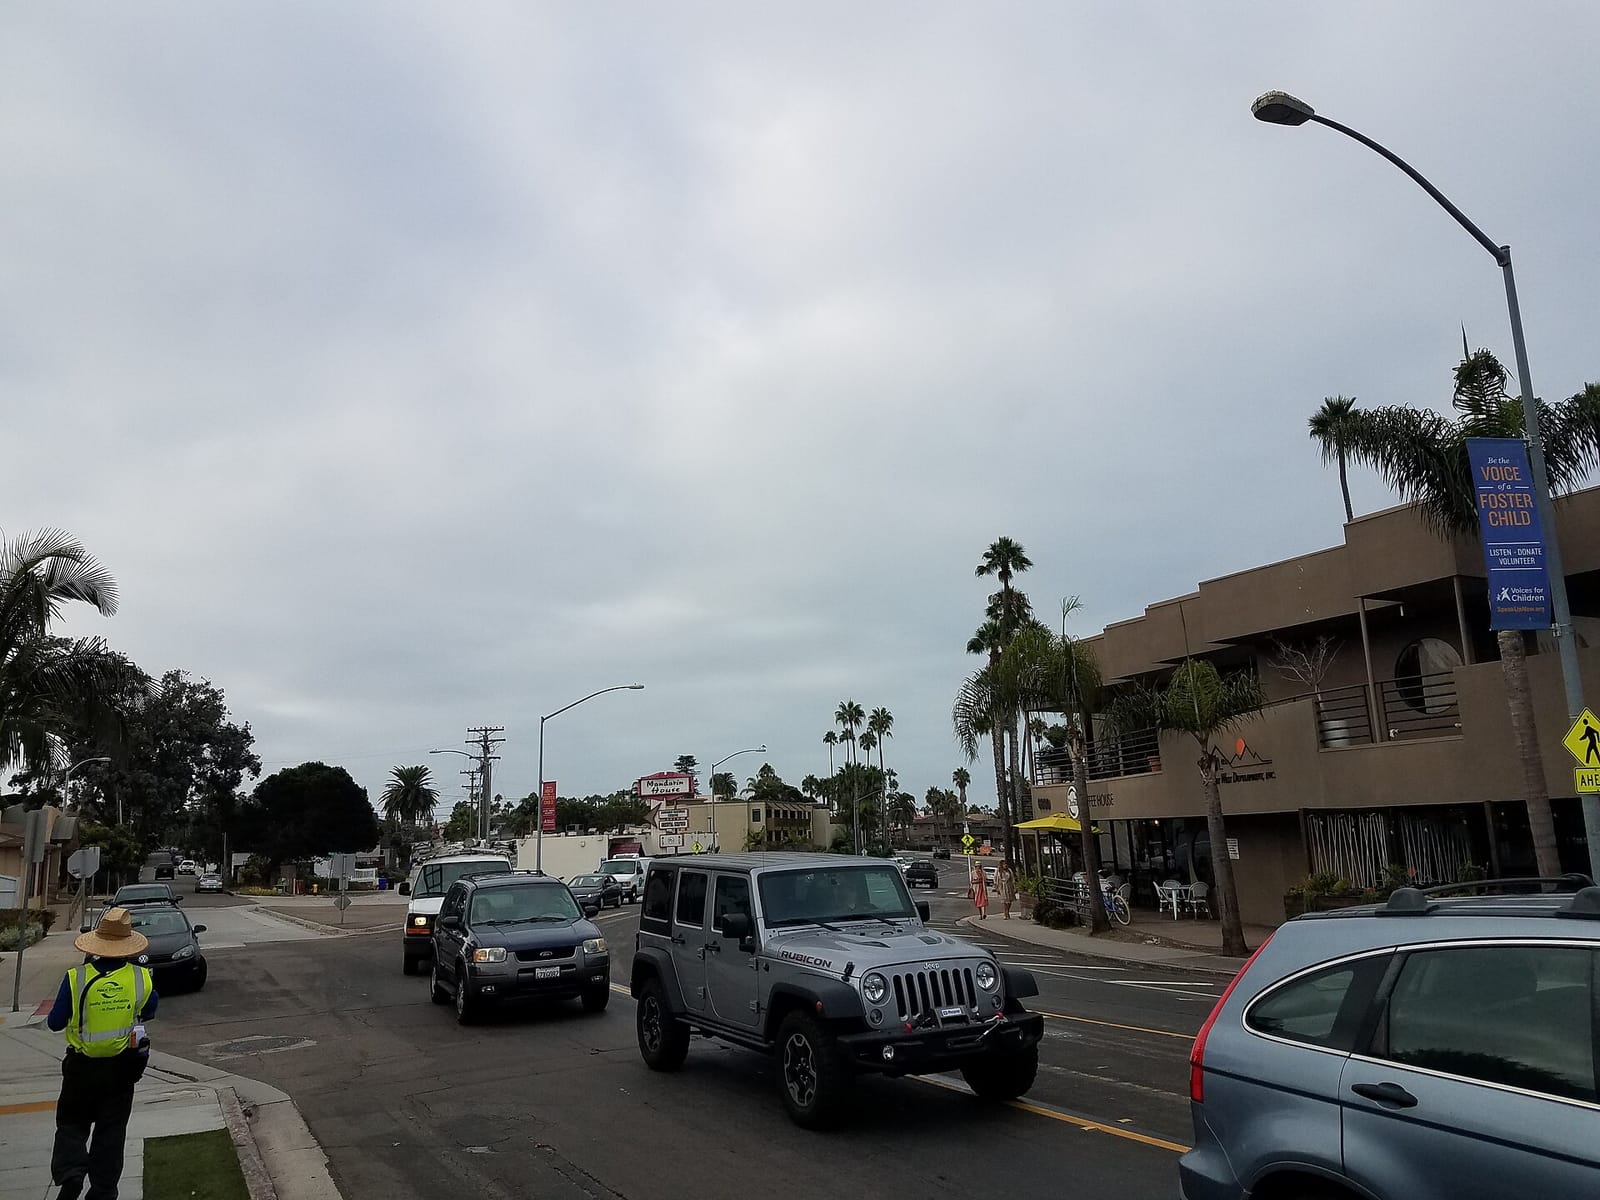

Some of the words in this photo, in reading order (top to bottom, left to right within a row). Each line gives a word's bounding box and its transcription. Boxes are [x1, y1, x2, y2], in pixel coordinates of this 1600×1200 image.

[1480, 466, 1522, 481] VOICE
[1479, 493, 1533, 509] FOSTER
[1488, 510, 1531, 526] CHILD
[1489, 548, 1512, 556] LISTEN
[1517, 547, 1542, 556] DONATE
[1498, 557, 1536, 565] VOLUNTEER
[1534, 586, 1544, 594] for
[1511, 594, 1545, 602] Children
[646, 779, 684, 788] Mandarin
[780, 950, 833, 969] RUBICON
[923, 962, 940, 971] Jeep
